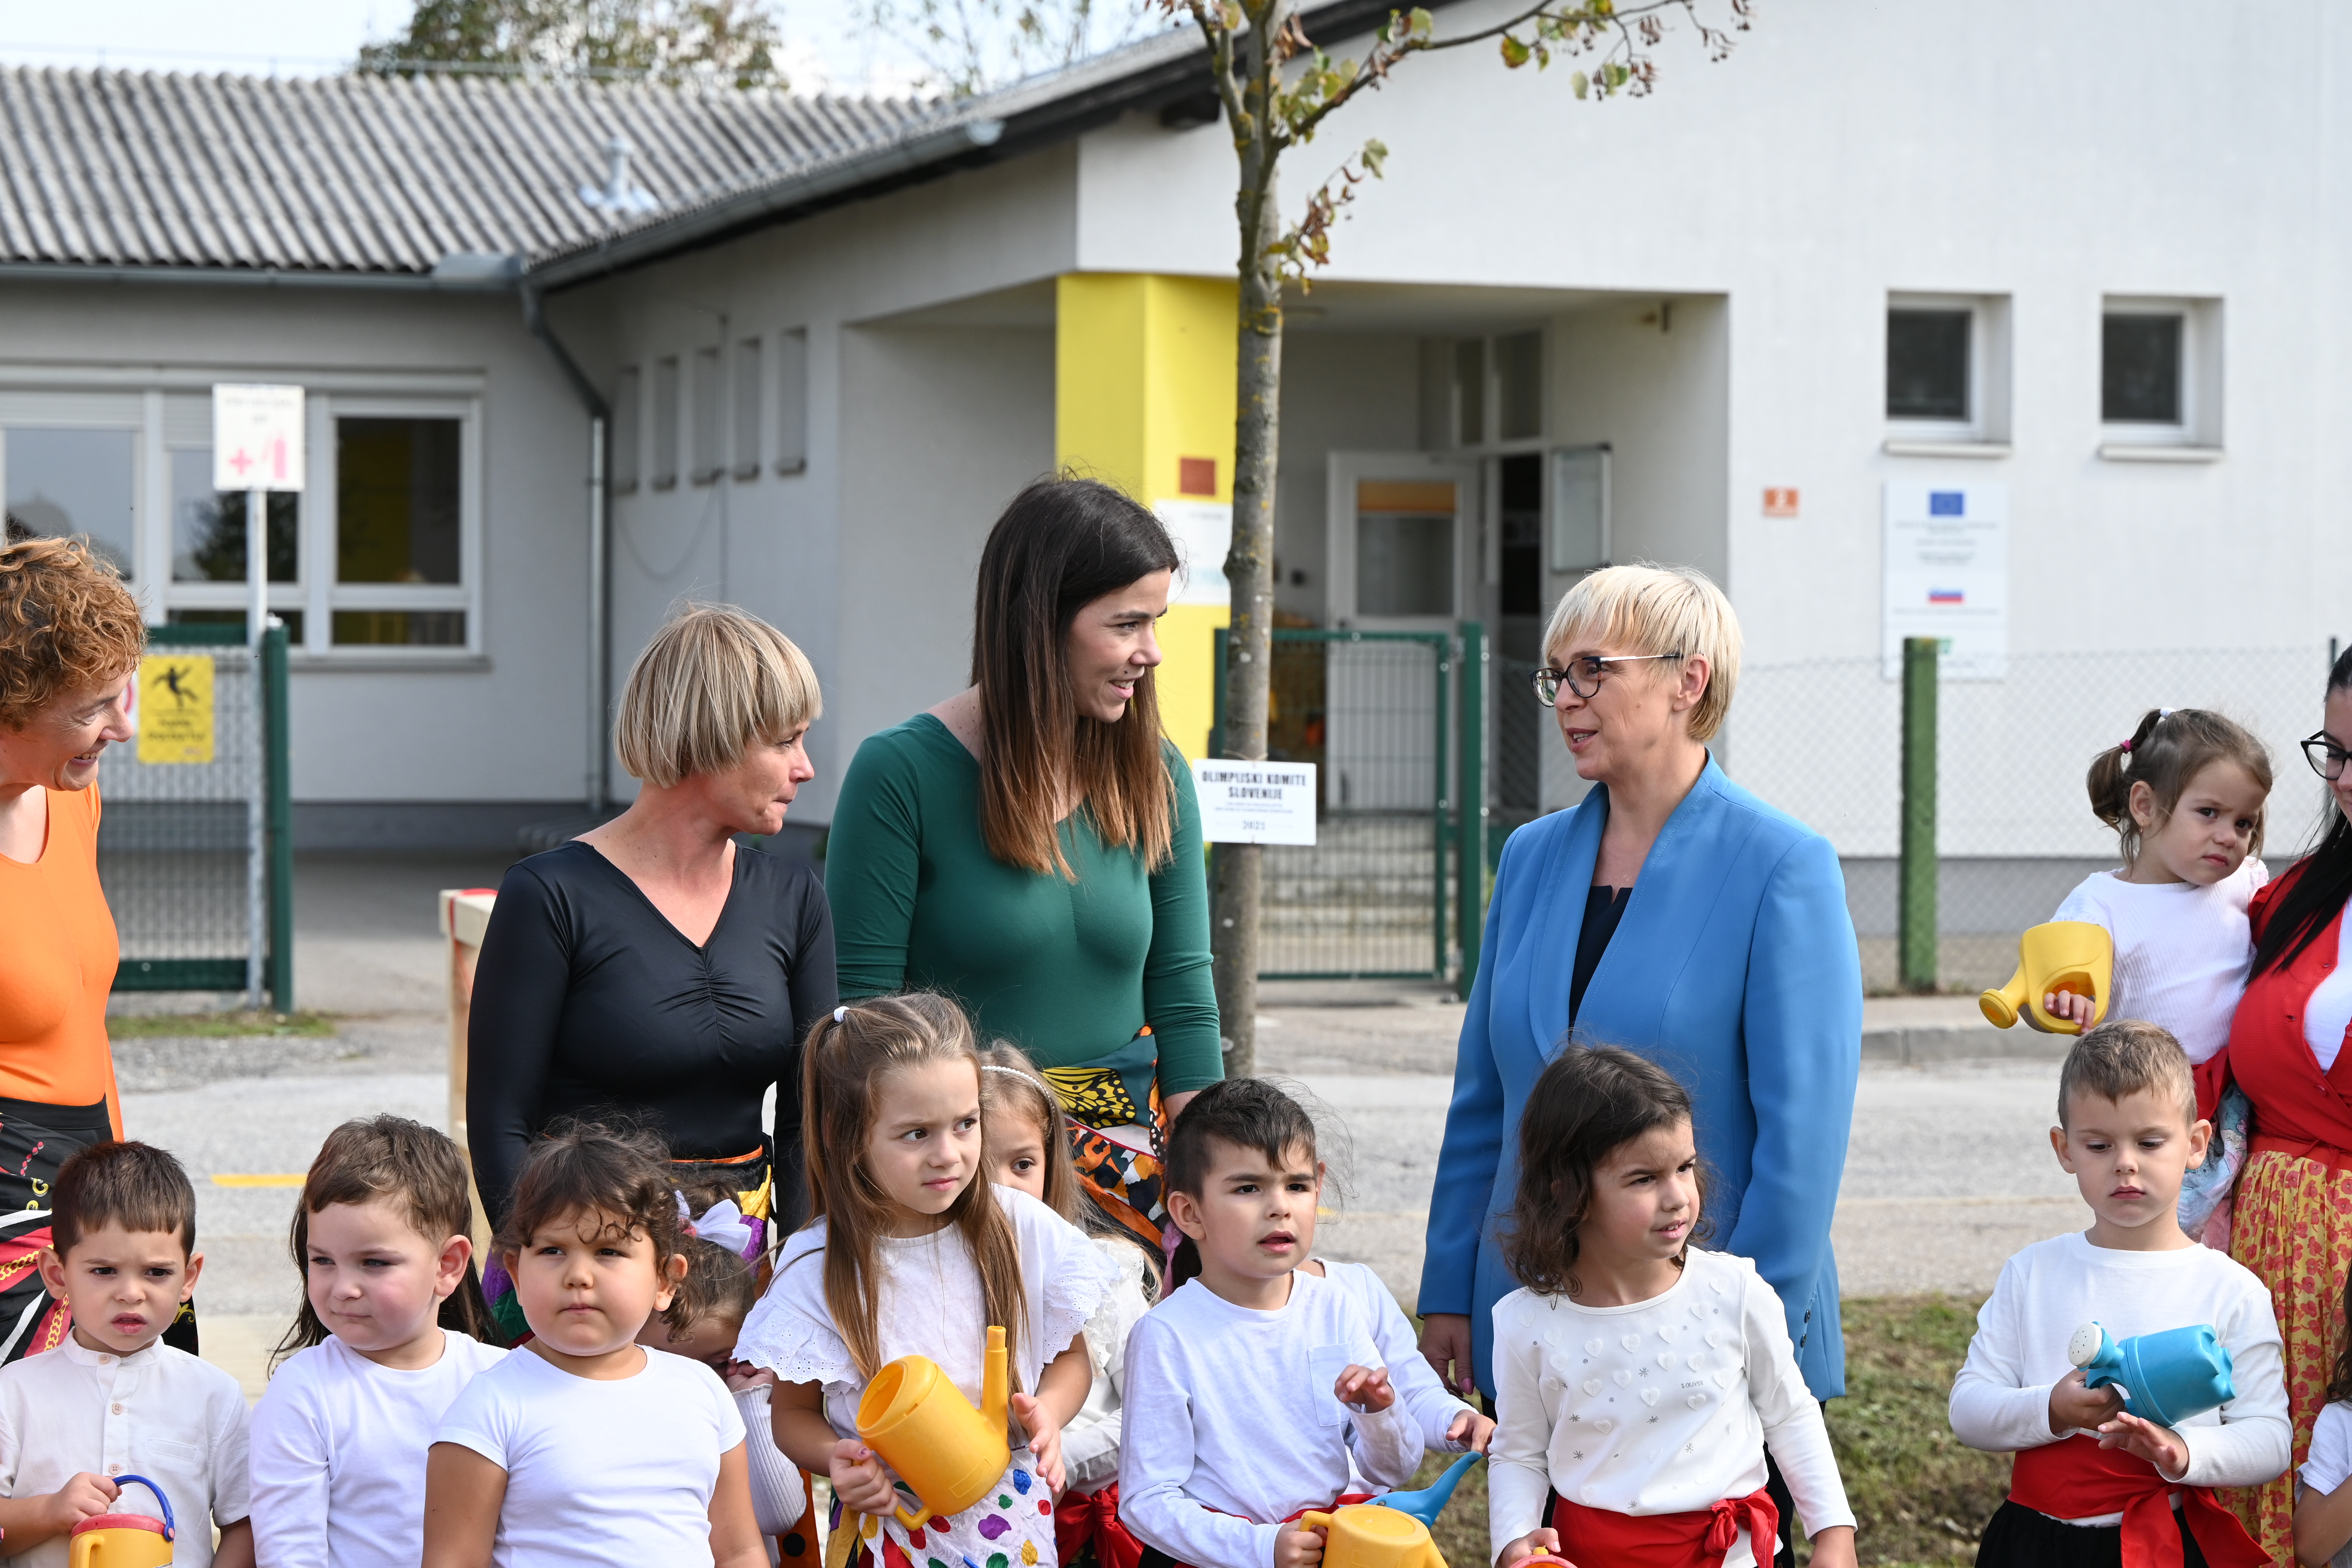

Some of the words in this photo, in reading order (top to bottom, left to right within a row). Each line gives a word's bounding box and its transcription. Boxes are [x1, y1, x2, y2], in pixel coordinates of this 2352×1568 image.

[1202, 771, 1262, 784] OLIMPIJSKI
[1266, 773, 1306, 786] KOMITE
[1229, 787, 1282, 799] SLOVENIJE
